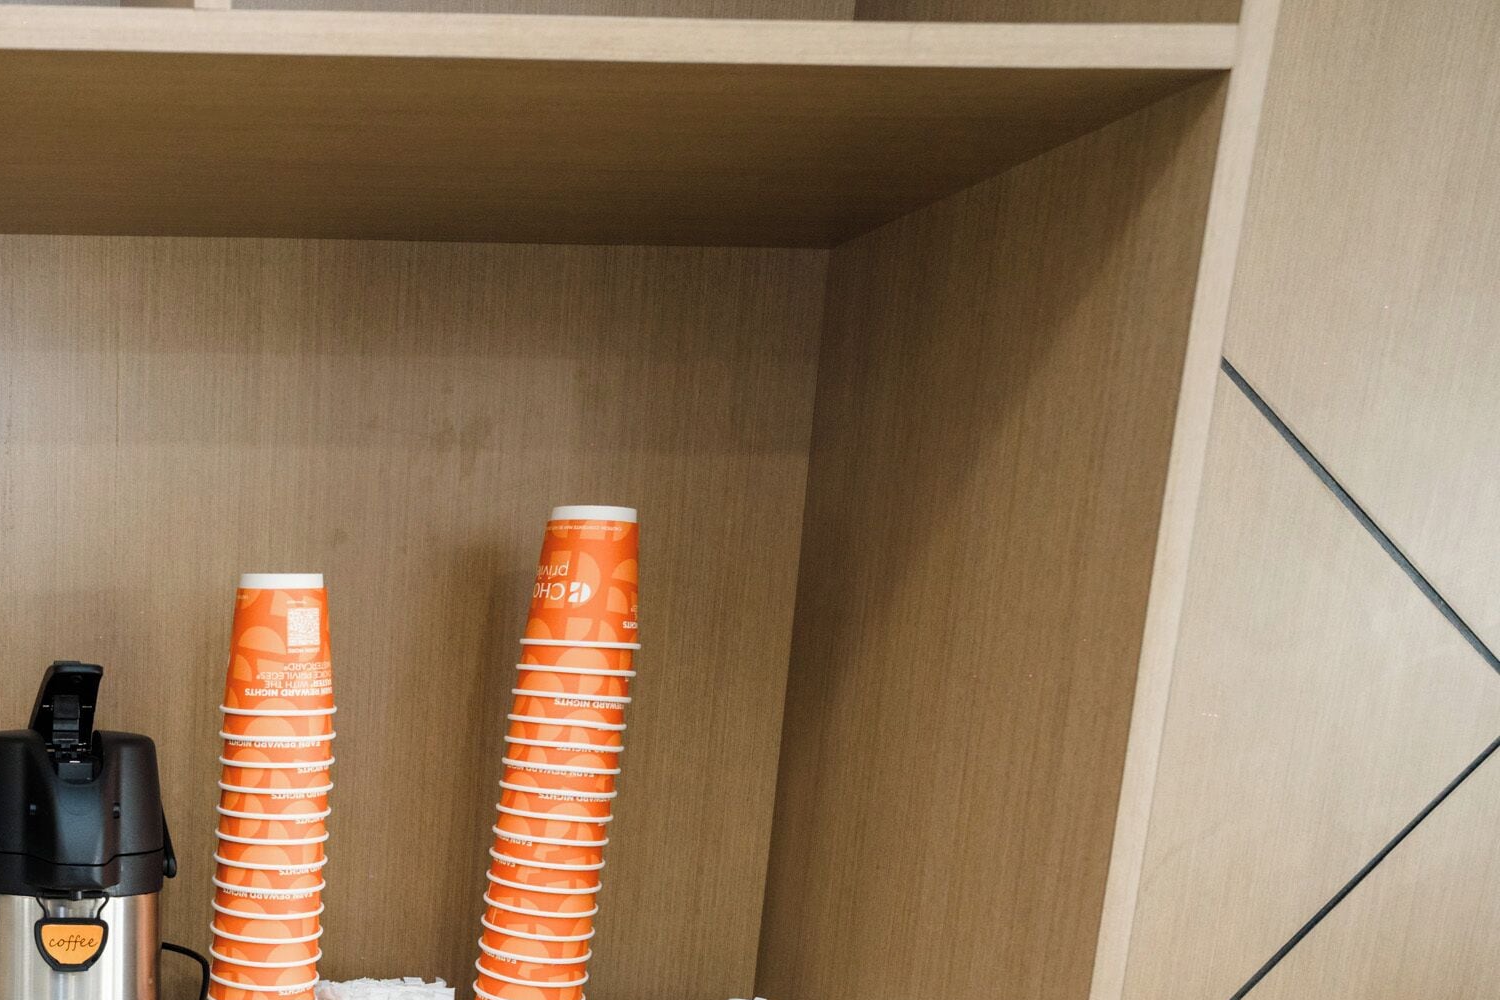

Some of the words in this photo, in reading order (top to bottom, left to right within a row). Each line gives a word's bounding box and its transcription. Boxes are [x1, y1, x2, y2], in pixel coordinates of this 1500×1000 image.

[533, 582, 566, 601] CHO
[264, 680, 283, 688] THE
[244, 688, 279, 697] NIGHTS
[281, 687, 320, 696] REWARD
[48, 934, 98, 951] coffee
